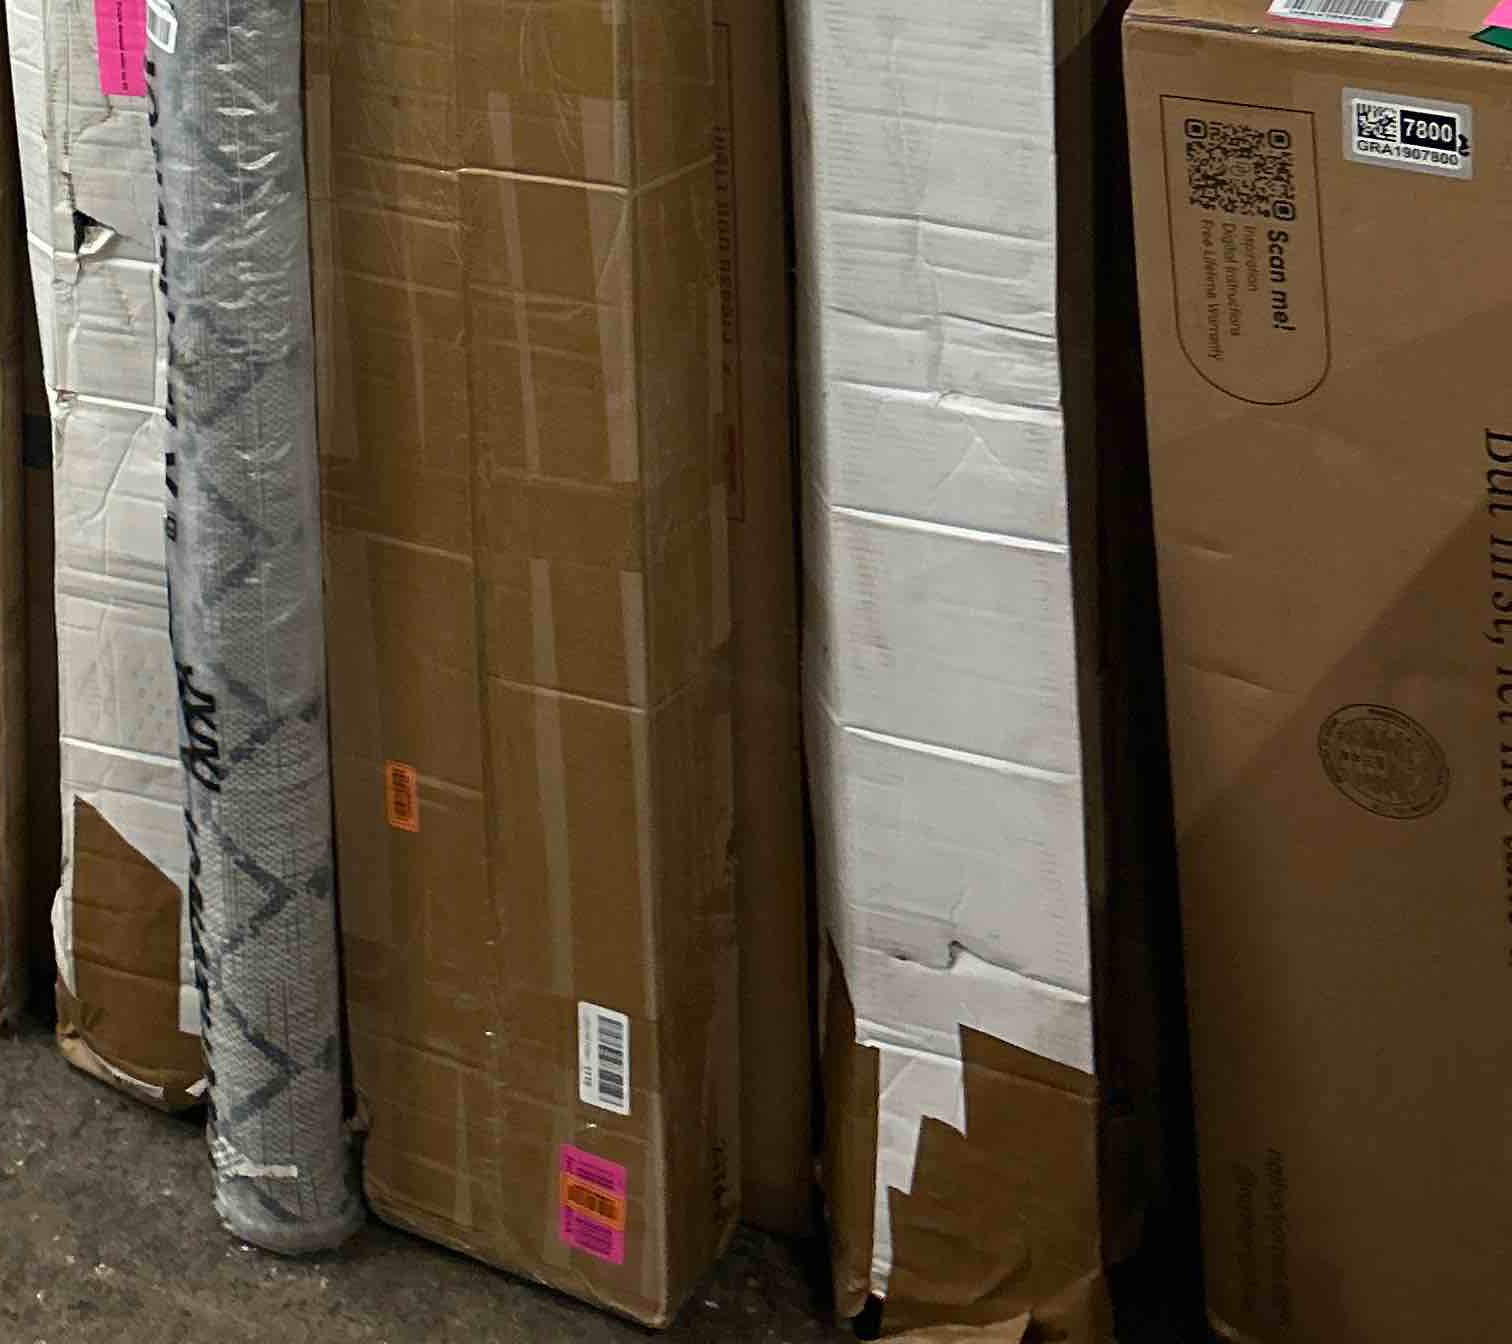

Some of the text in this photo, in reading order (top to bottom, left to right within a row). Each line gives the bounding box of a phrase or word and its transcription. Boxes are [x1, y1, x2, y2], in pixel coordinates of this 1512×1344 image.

[1402, 117, 1453, 143] 7800
[1222, 222, 1240, 264] Digital
[1240, 224, 1260, 293] Inspiration
[1200, 218, 1226, 362] Free Lifetime Warranty
[1267, 229, 1297, 333] Scan me!
